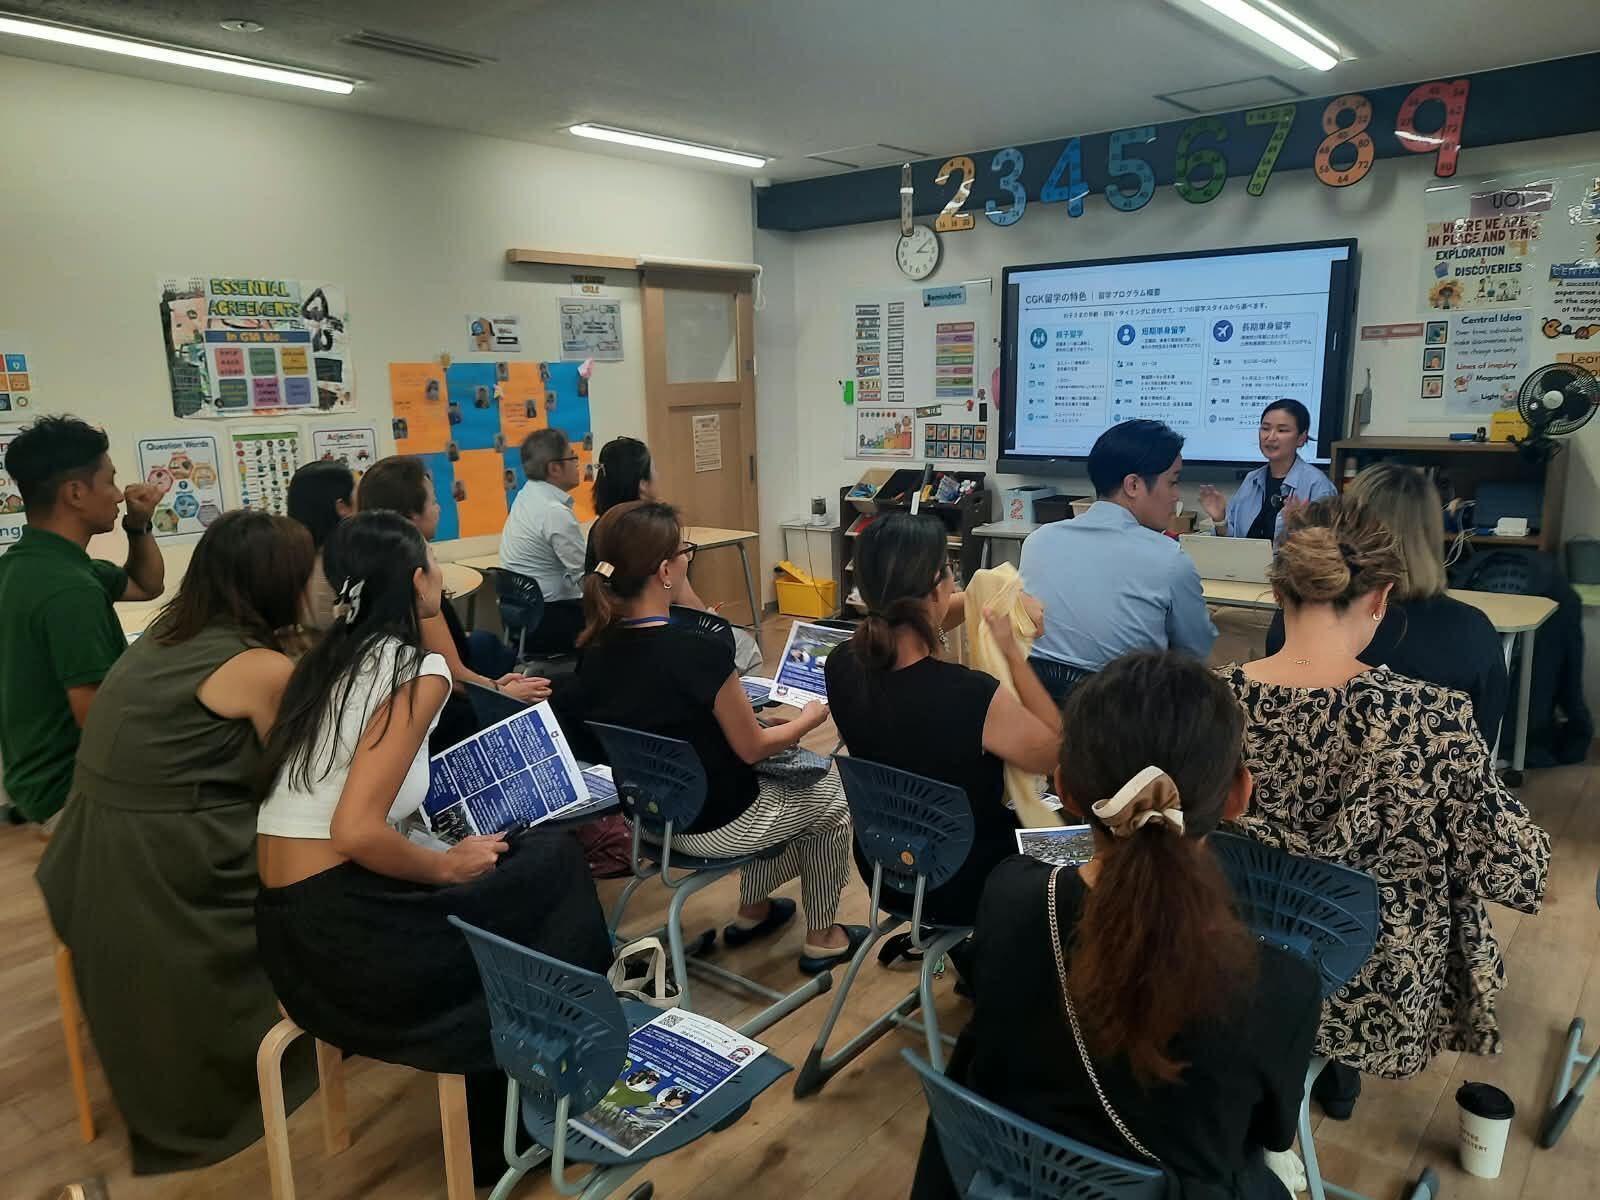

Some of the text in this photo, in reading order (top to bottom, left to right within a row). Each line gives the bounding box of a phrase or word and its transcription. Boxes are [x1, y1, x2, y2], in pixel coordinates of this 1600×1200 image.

[935, 156, 976, 232] 2
[985, 148, 1027, 227] 3
[1040, 136, 1090, 217] 4
[1105, 127, 1157, 212] 5
[1173, 117, 1229, 204] 6
[1245, 103, 1297, 196] 7
[1315, 94, 1375, 187] 8
[1396, 79, 1470, 177] 9
[1443, 219, 1482, 234] WHRE
[1485, 218, 1500, 230] WE
[1428, 236, 1440, 248] IN
[1482, 230, 1506, 243] AND
[1435, 245, 1506, 261] EXPLORATION
[1454, 262, 1523, 277] DISCOVERIES
[209, 279, 290, 297] ESSENTIAL
[207, 299, 302, 317] AGREEMENTS
[1461, 313, 1522, 325] Central Idea
[1456, 362, 1476, 370] Lines
[1488, 359, 1519, 370] inquiry
[1475, 374, 1516, 383] Magnetism
[1481, 392, 1500, 401] Light
[327, 432, 364, 443] Adjectives
[146, 442, 182, 451] Question
